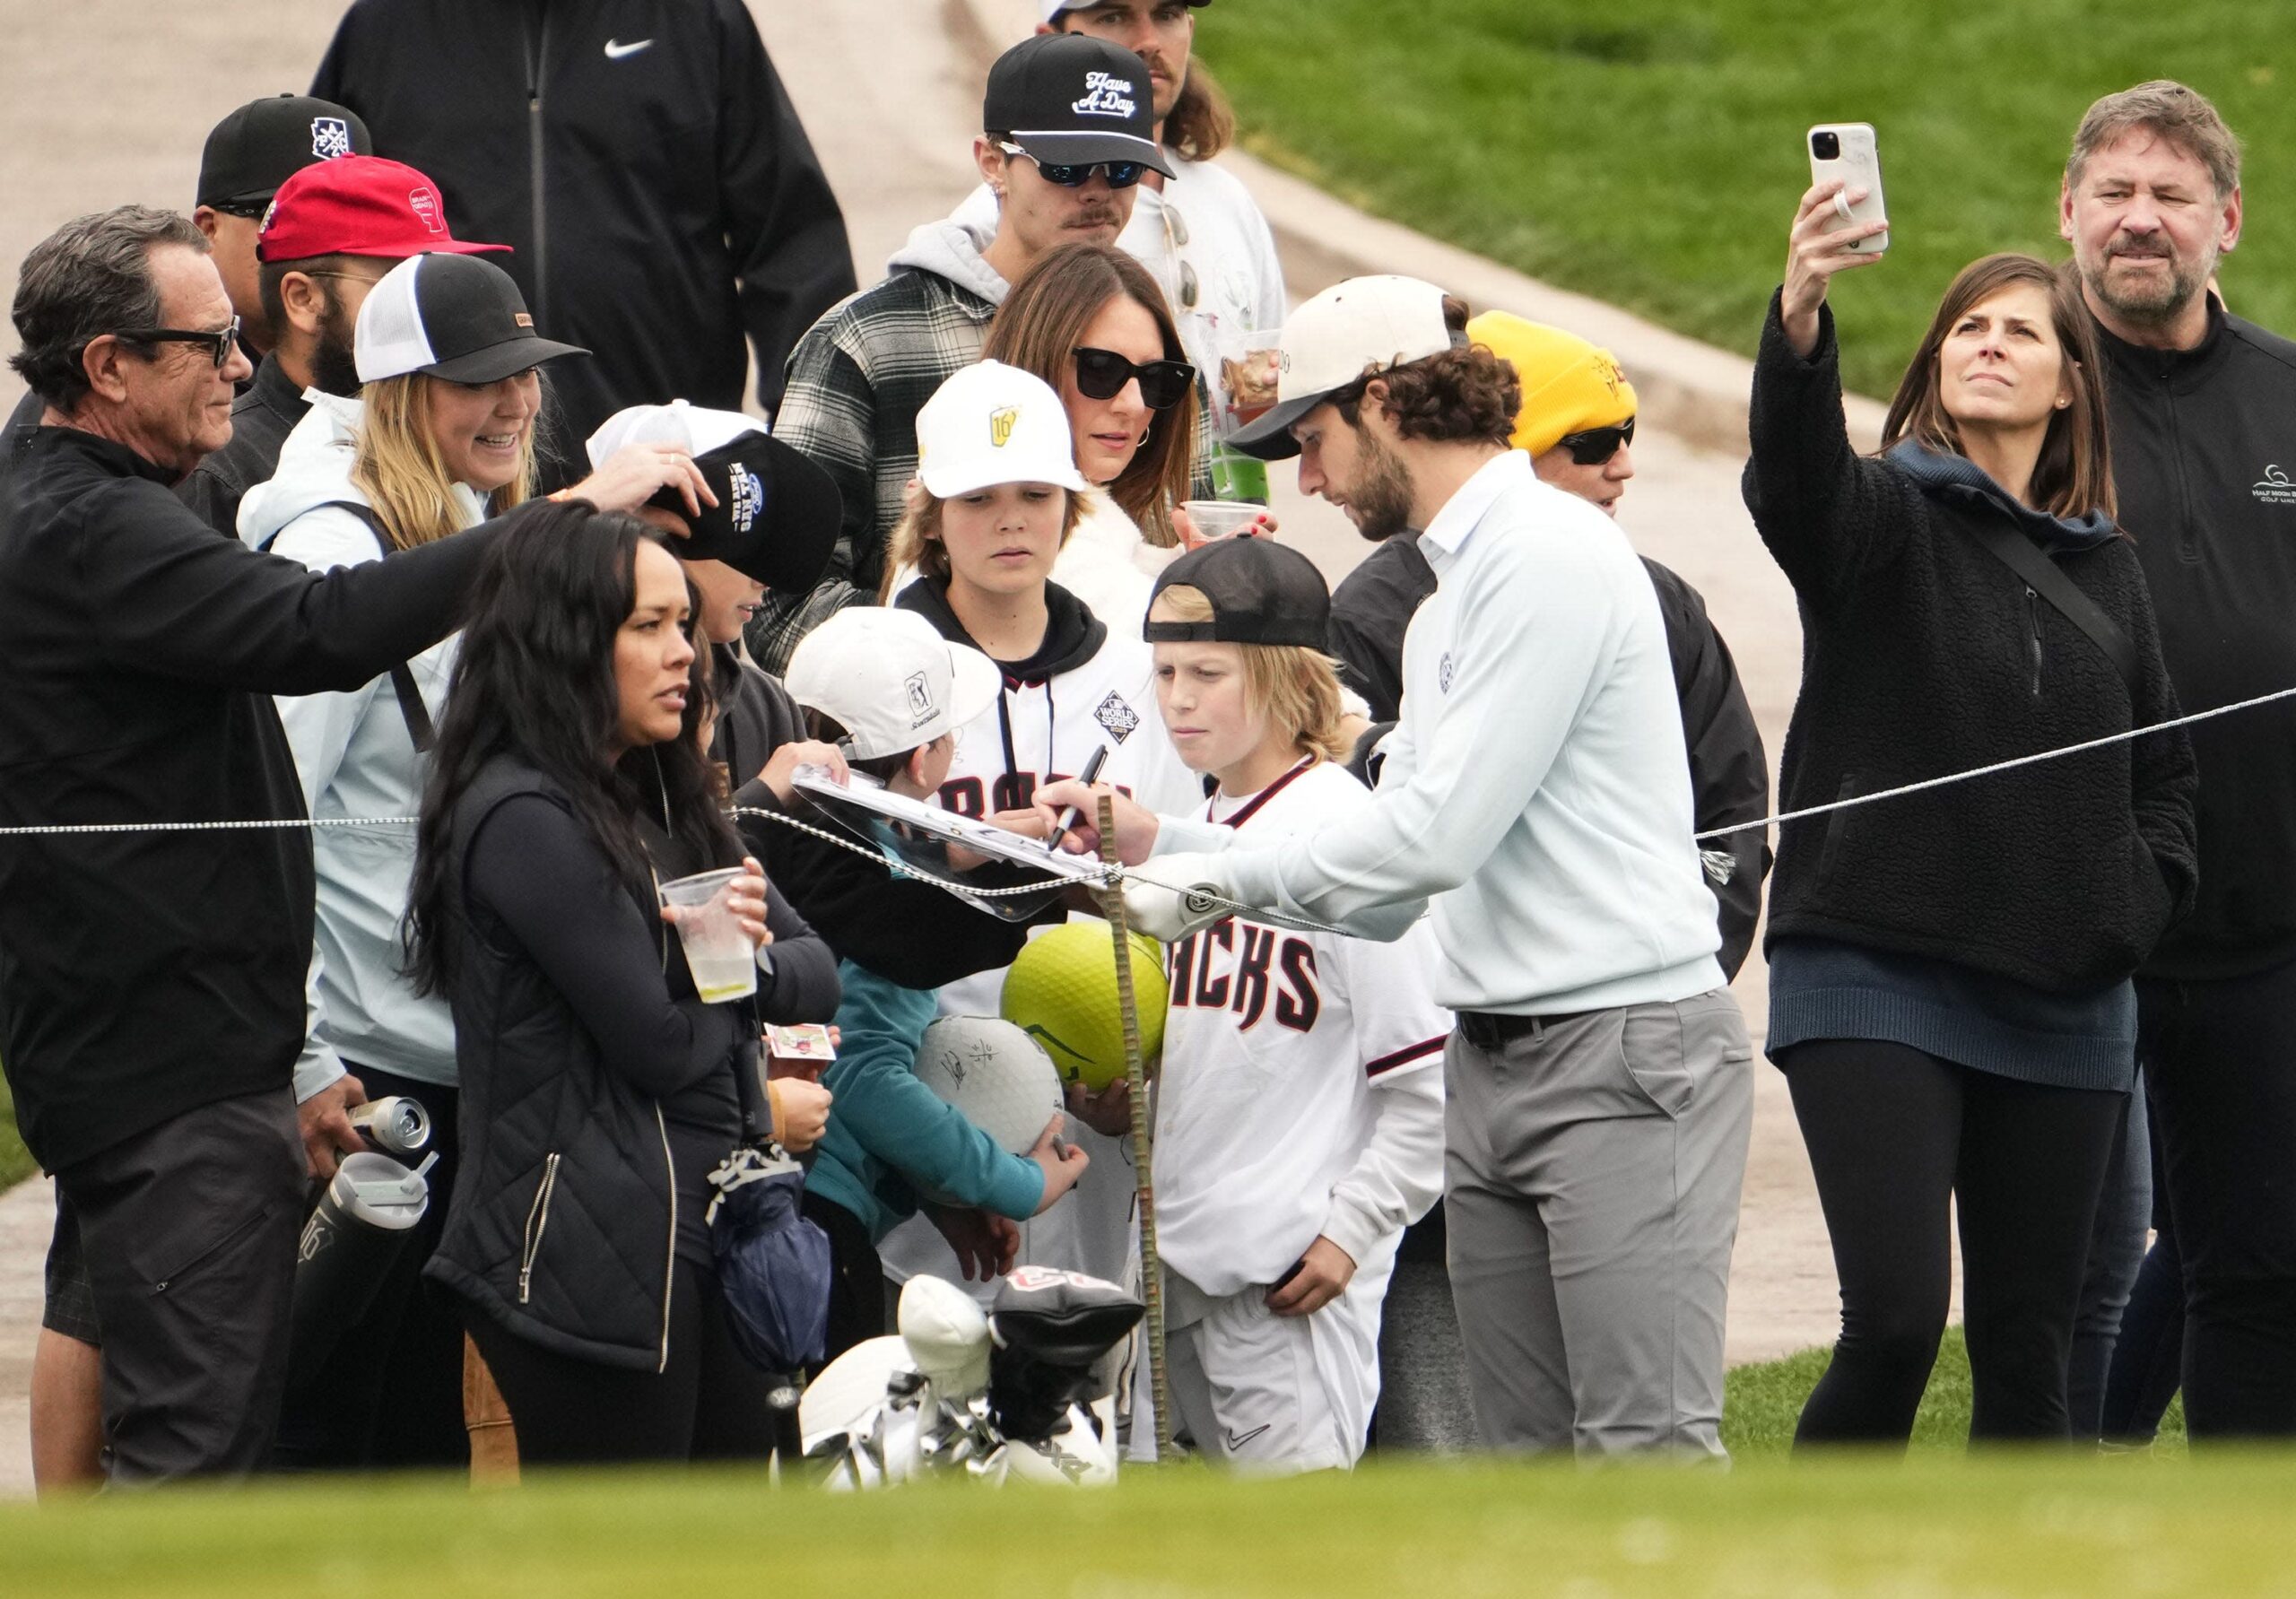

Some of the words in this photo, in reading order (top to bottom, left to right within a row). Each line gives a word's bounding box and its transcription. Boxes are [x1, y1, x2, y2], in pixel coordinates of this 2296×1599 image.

[1085, 71, 1132, 94] Have
[1079, 90, 1100, 111] A
[1100, 91, 1136, 117] Day
[994, 413, 1011, 438] 16
[1100, 708, 1134, 720] WORLD
[1101, 716, 1135, 729] SERIES
